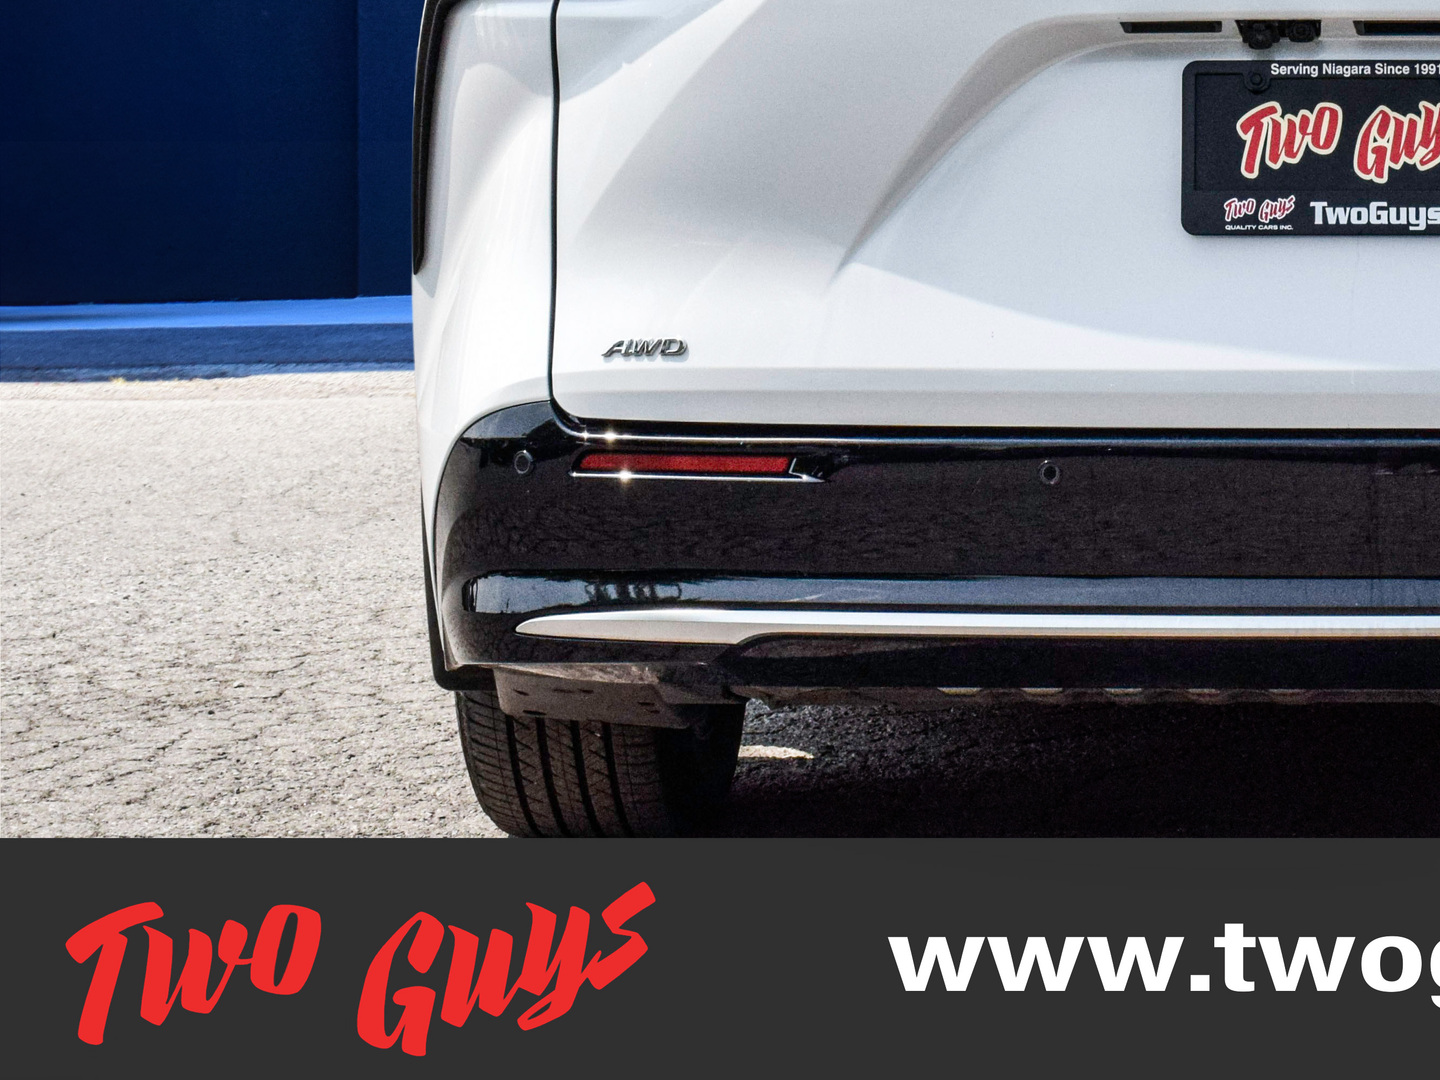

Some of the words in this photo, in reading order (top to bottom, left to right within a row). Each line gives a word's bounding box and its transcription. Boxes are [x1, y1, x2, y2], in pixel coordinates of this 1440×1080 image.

[1270, 63, 1319, 77] Serving
[1322, 63, 1371, 77] Niagara
[1375, 63, 1410, 75] Since
[1237, 101, 1343, 179] Two
[1224, 197, 1256, 222] Two
[1258, 195, 1296, 223] Guys
[601, 338, 689, 358] AWD
